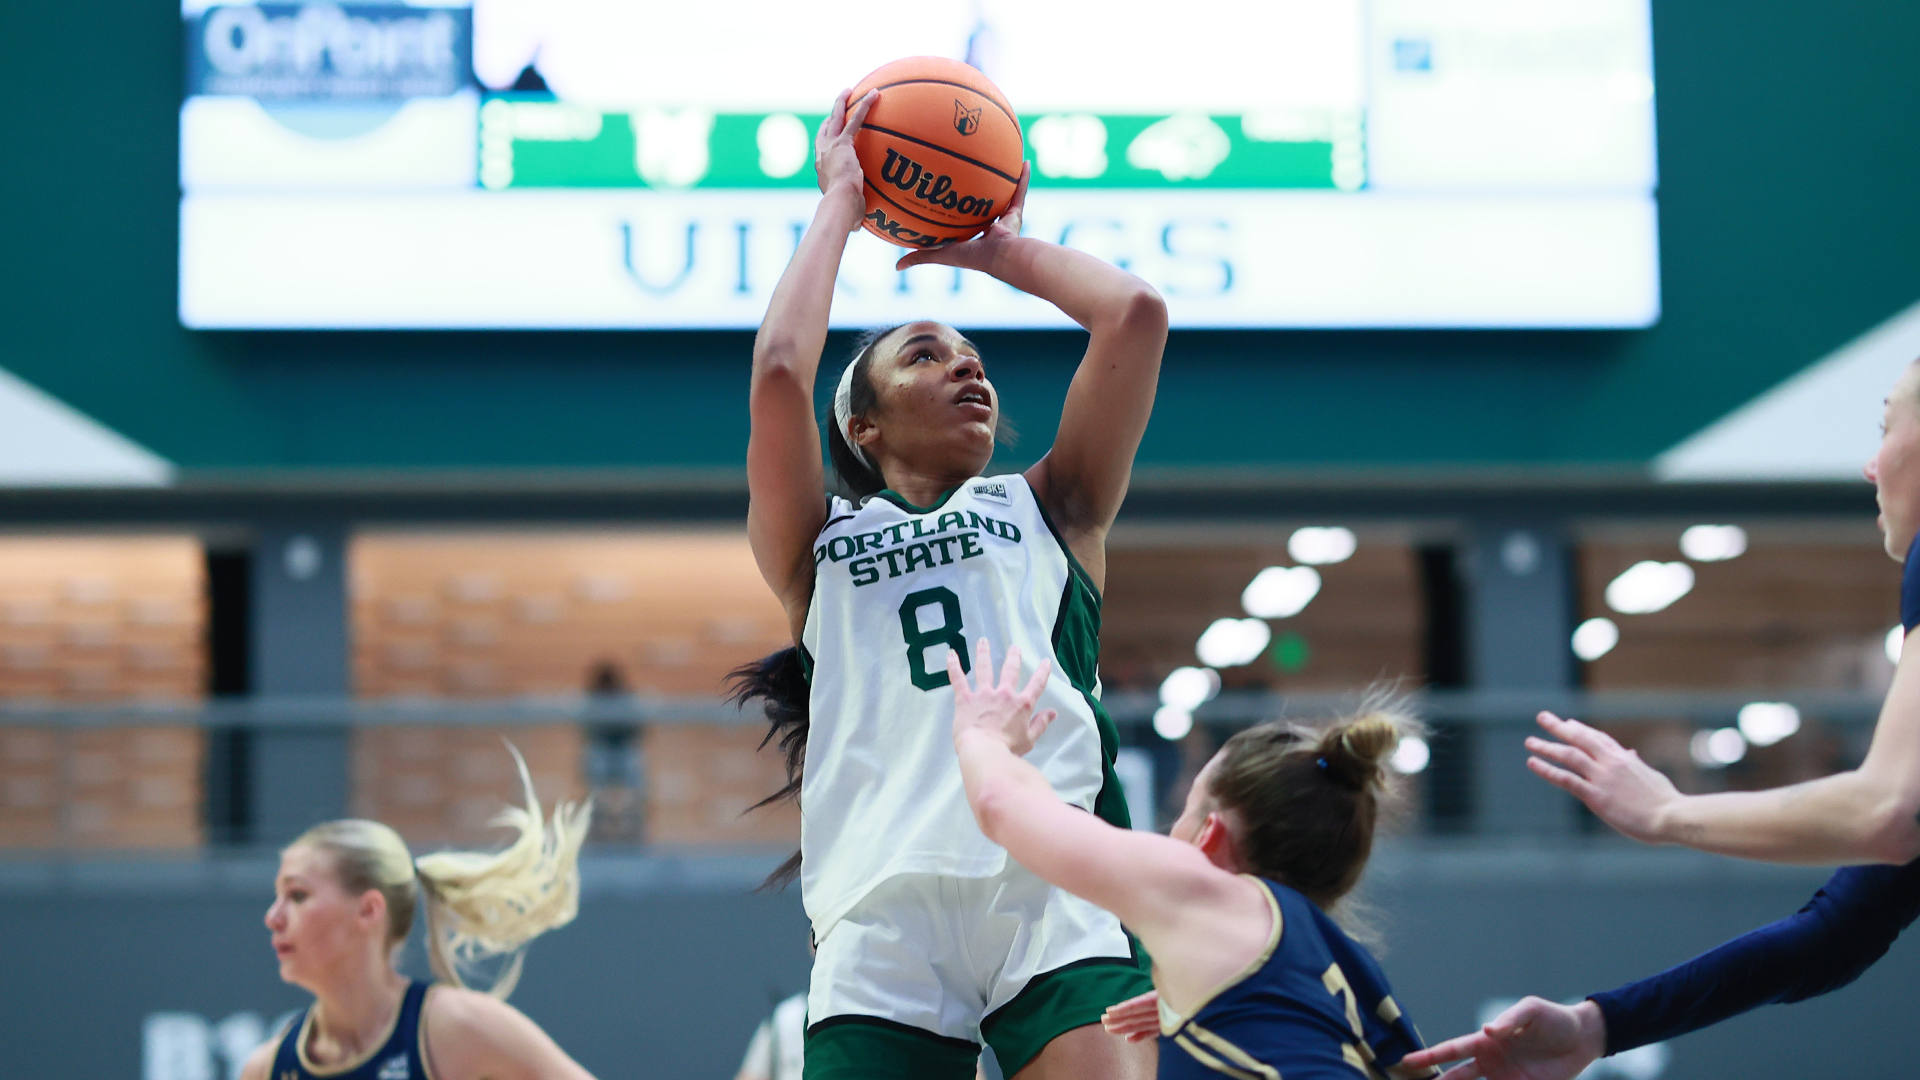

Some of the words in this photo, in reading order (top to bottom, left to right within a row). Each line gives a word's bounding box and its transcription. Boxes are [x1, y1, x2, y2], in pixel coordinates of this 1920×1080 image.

[881, 147, 994, 217] Wilson
[814, 510, 1022, 575] PORTLAND
[849, 532, 984, 587] STATE
[898, 586, 971, 692] 8
